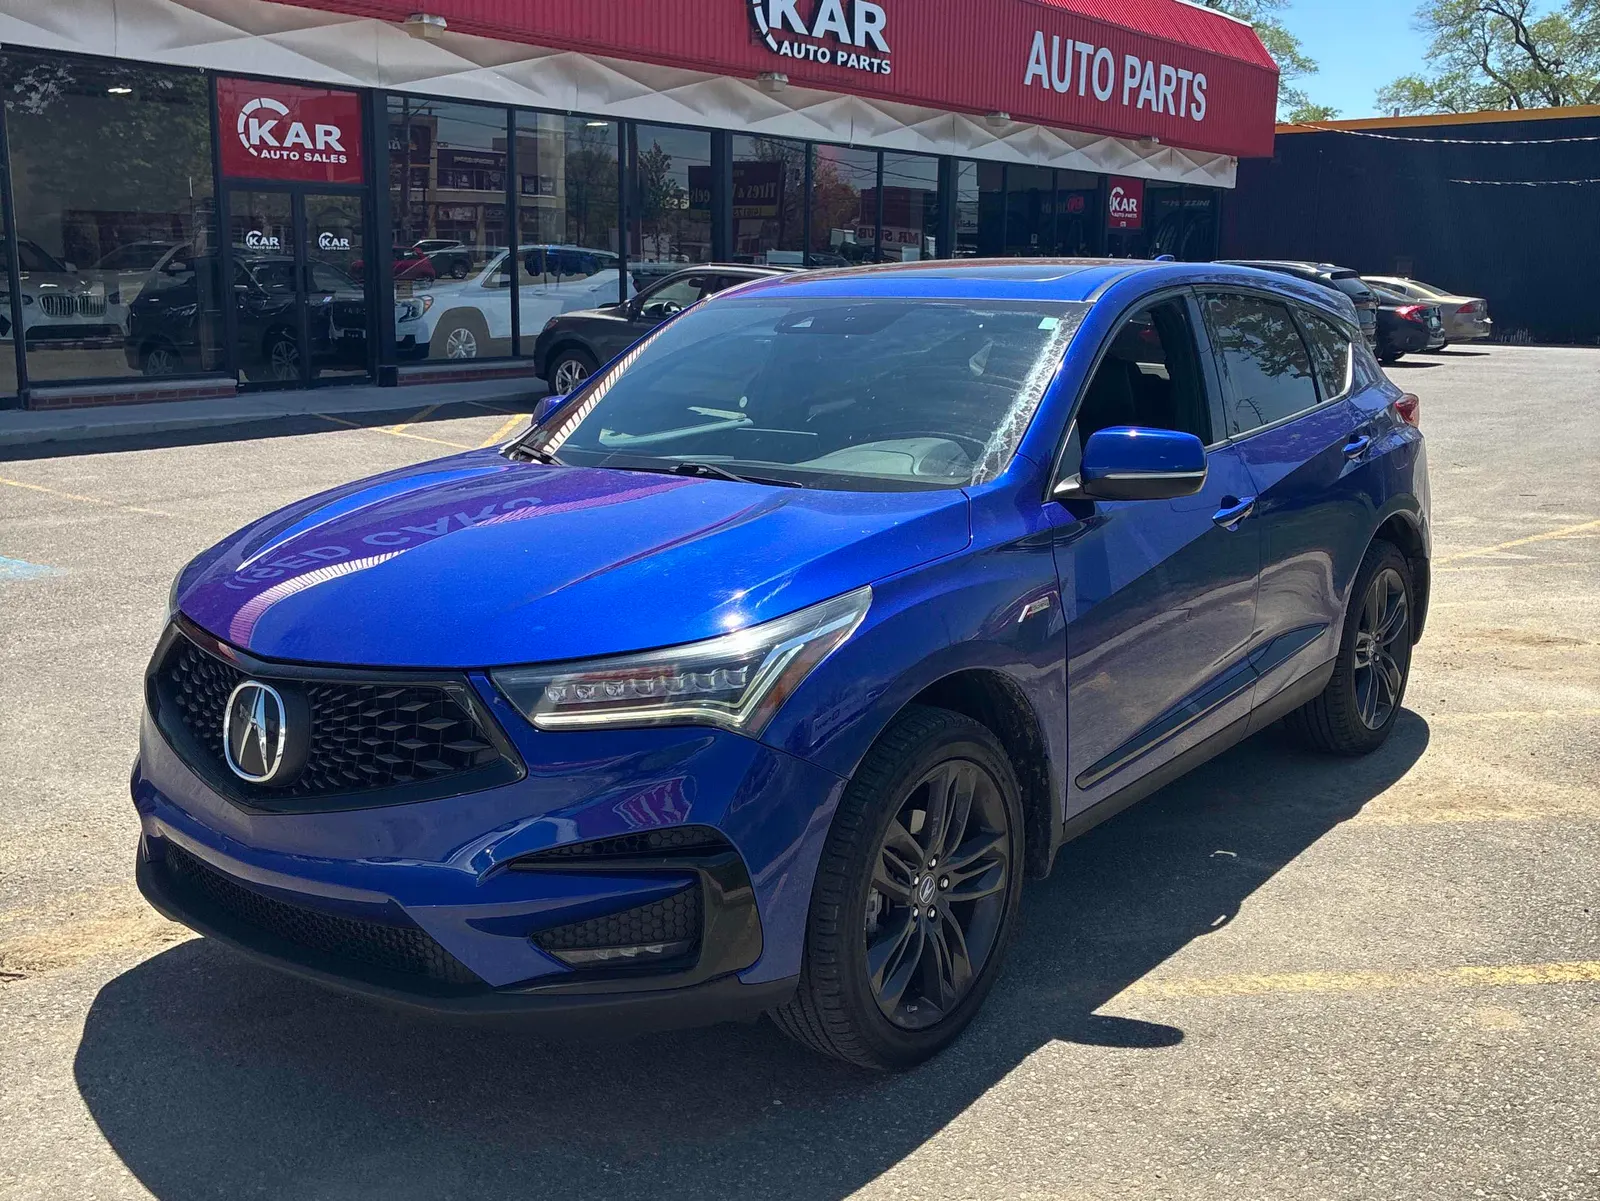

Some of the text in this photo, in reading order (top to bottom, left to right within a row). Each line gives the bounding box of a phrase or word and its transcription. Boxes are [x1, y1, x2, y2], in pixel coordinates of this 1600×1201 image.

[769, 0, 891, 53] KAR
[780, 40, 891, 74] AUTO PARTS
[1024, 30, 1207, 121] AUTO PARTS
[248, 118, 346, 152] KAR
[261, 149, 347, 164] AUTO SALES
[1112, 197, 1137, 212] KAR
[249, 236, 280, 246] KAR
[322, 237, 350, 247] KAR
